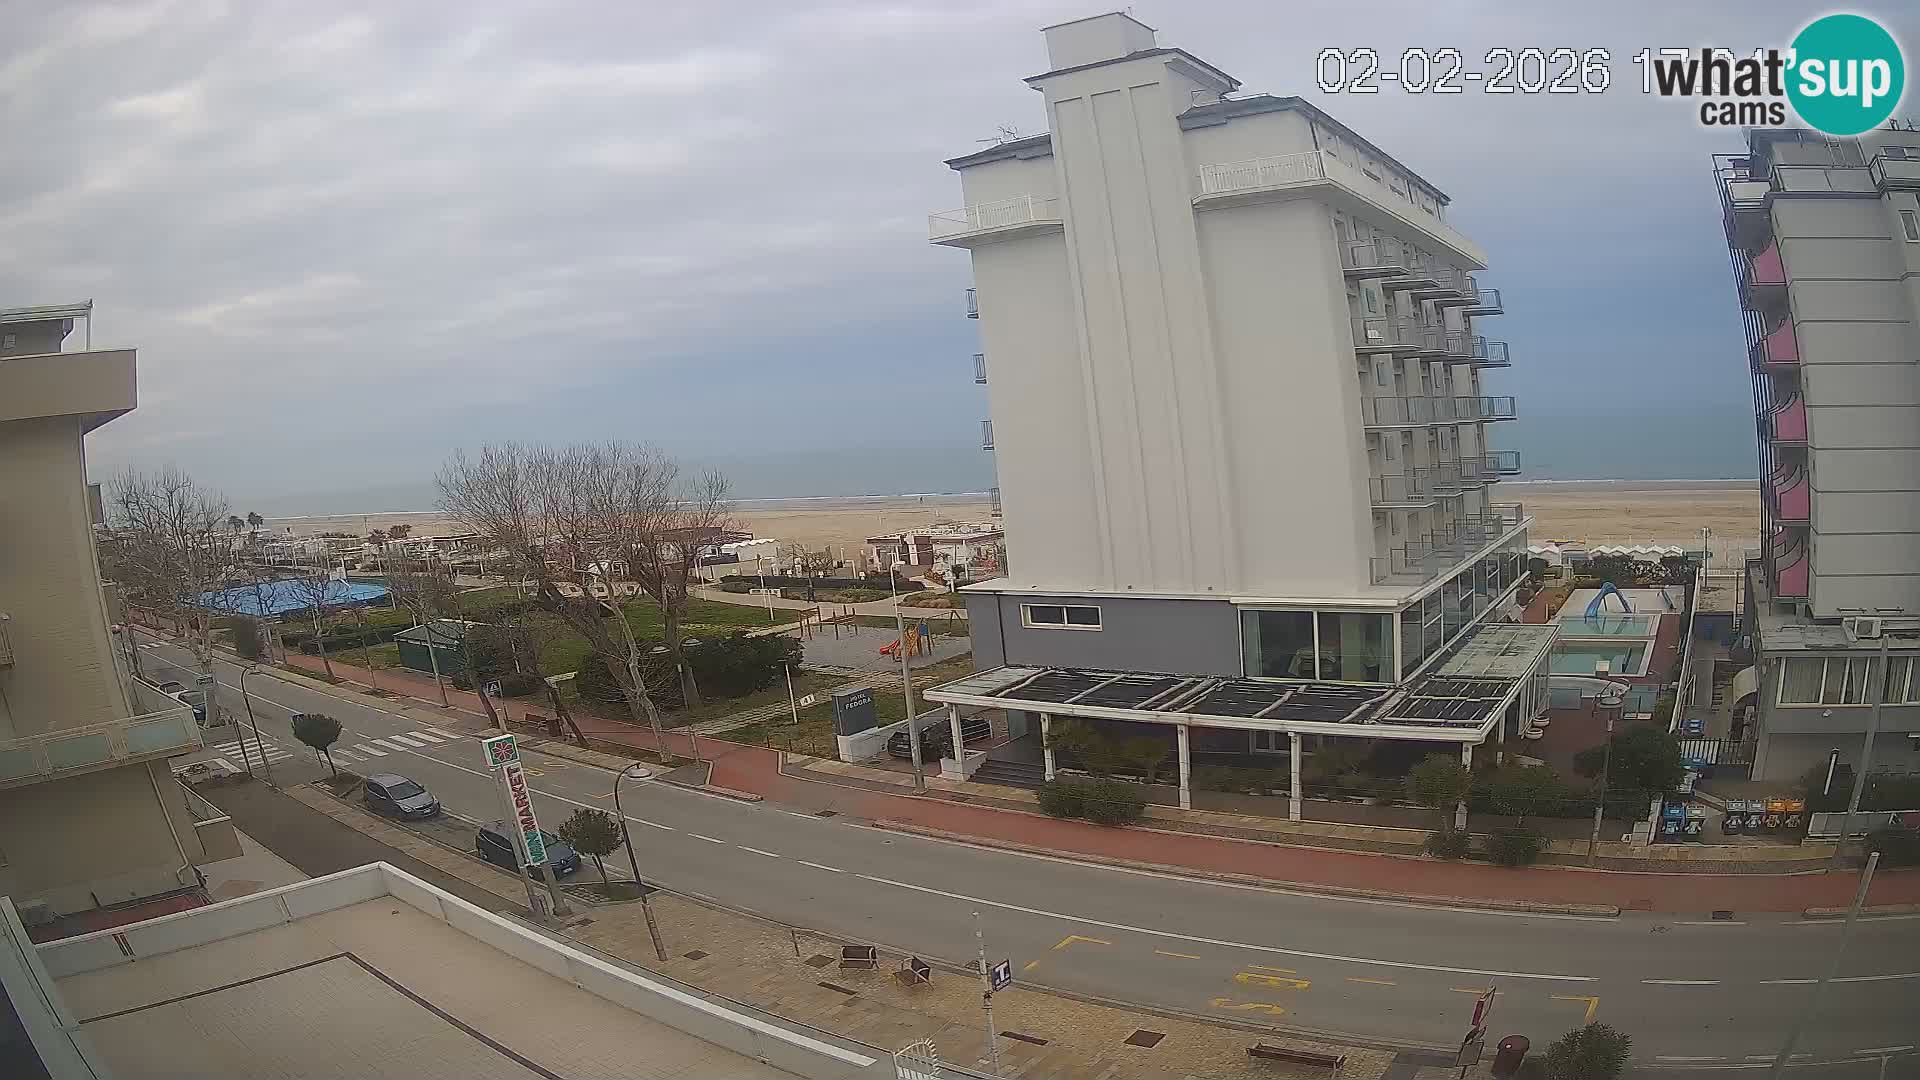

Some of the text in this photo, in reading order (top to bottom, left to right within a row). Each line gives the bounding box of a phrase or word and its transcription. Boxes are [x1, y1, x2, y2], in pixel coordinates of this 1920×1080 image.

[844, 697, 872, 710] FEDORA
[849, 693, 866, 702] HOTEL
[506, 766, 537, 832] MARKET
